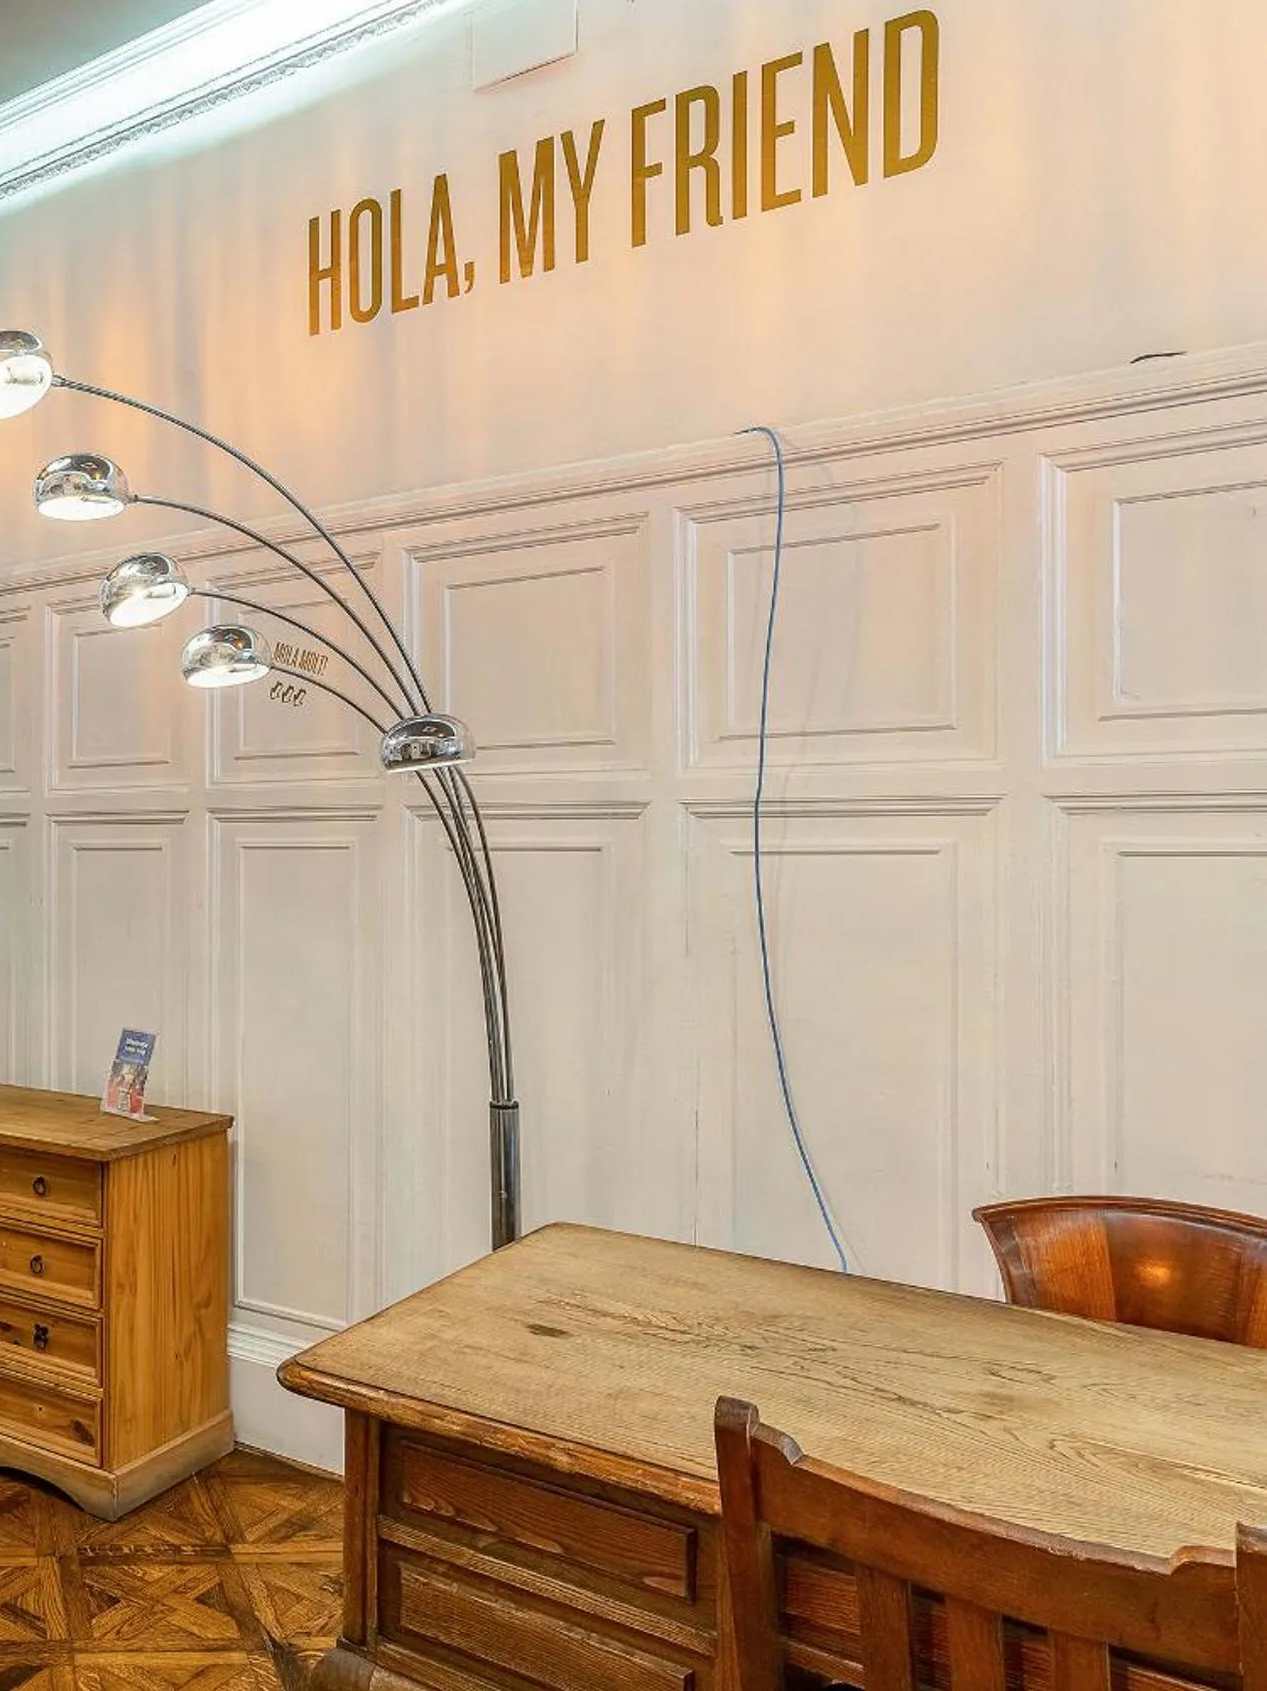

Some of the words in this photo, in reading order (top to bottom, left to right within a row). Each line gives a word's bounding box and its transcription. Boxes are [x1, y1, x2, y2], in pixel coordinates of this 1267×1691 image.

[308, 172, 475, 337] HOLA,
[498, 118, 606, 285] MY
[631, 8, 941, 249] FRIEND
